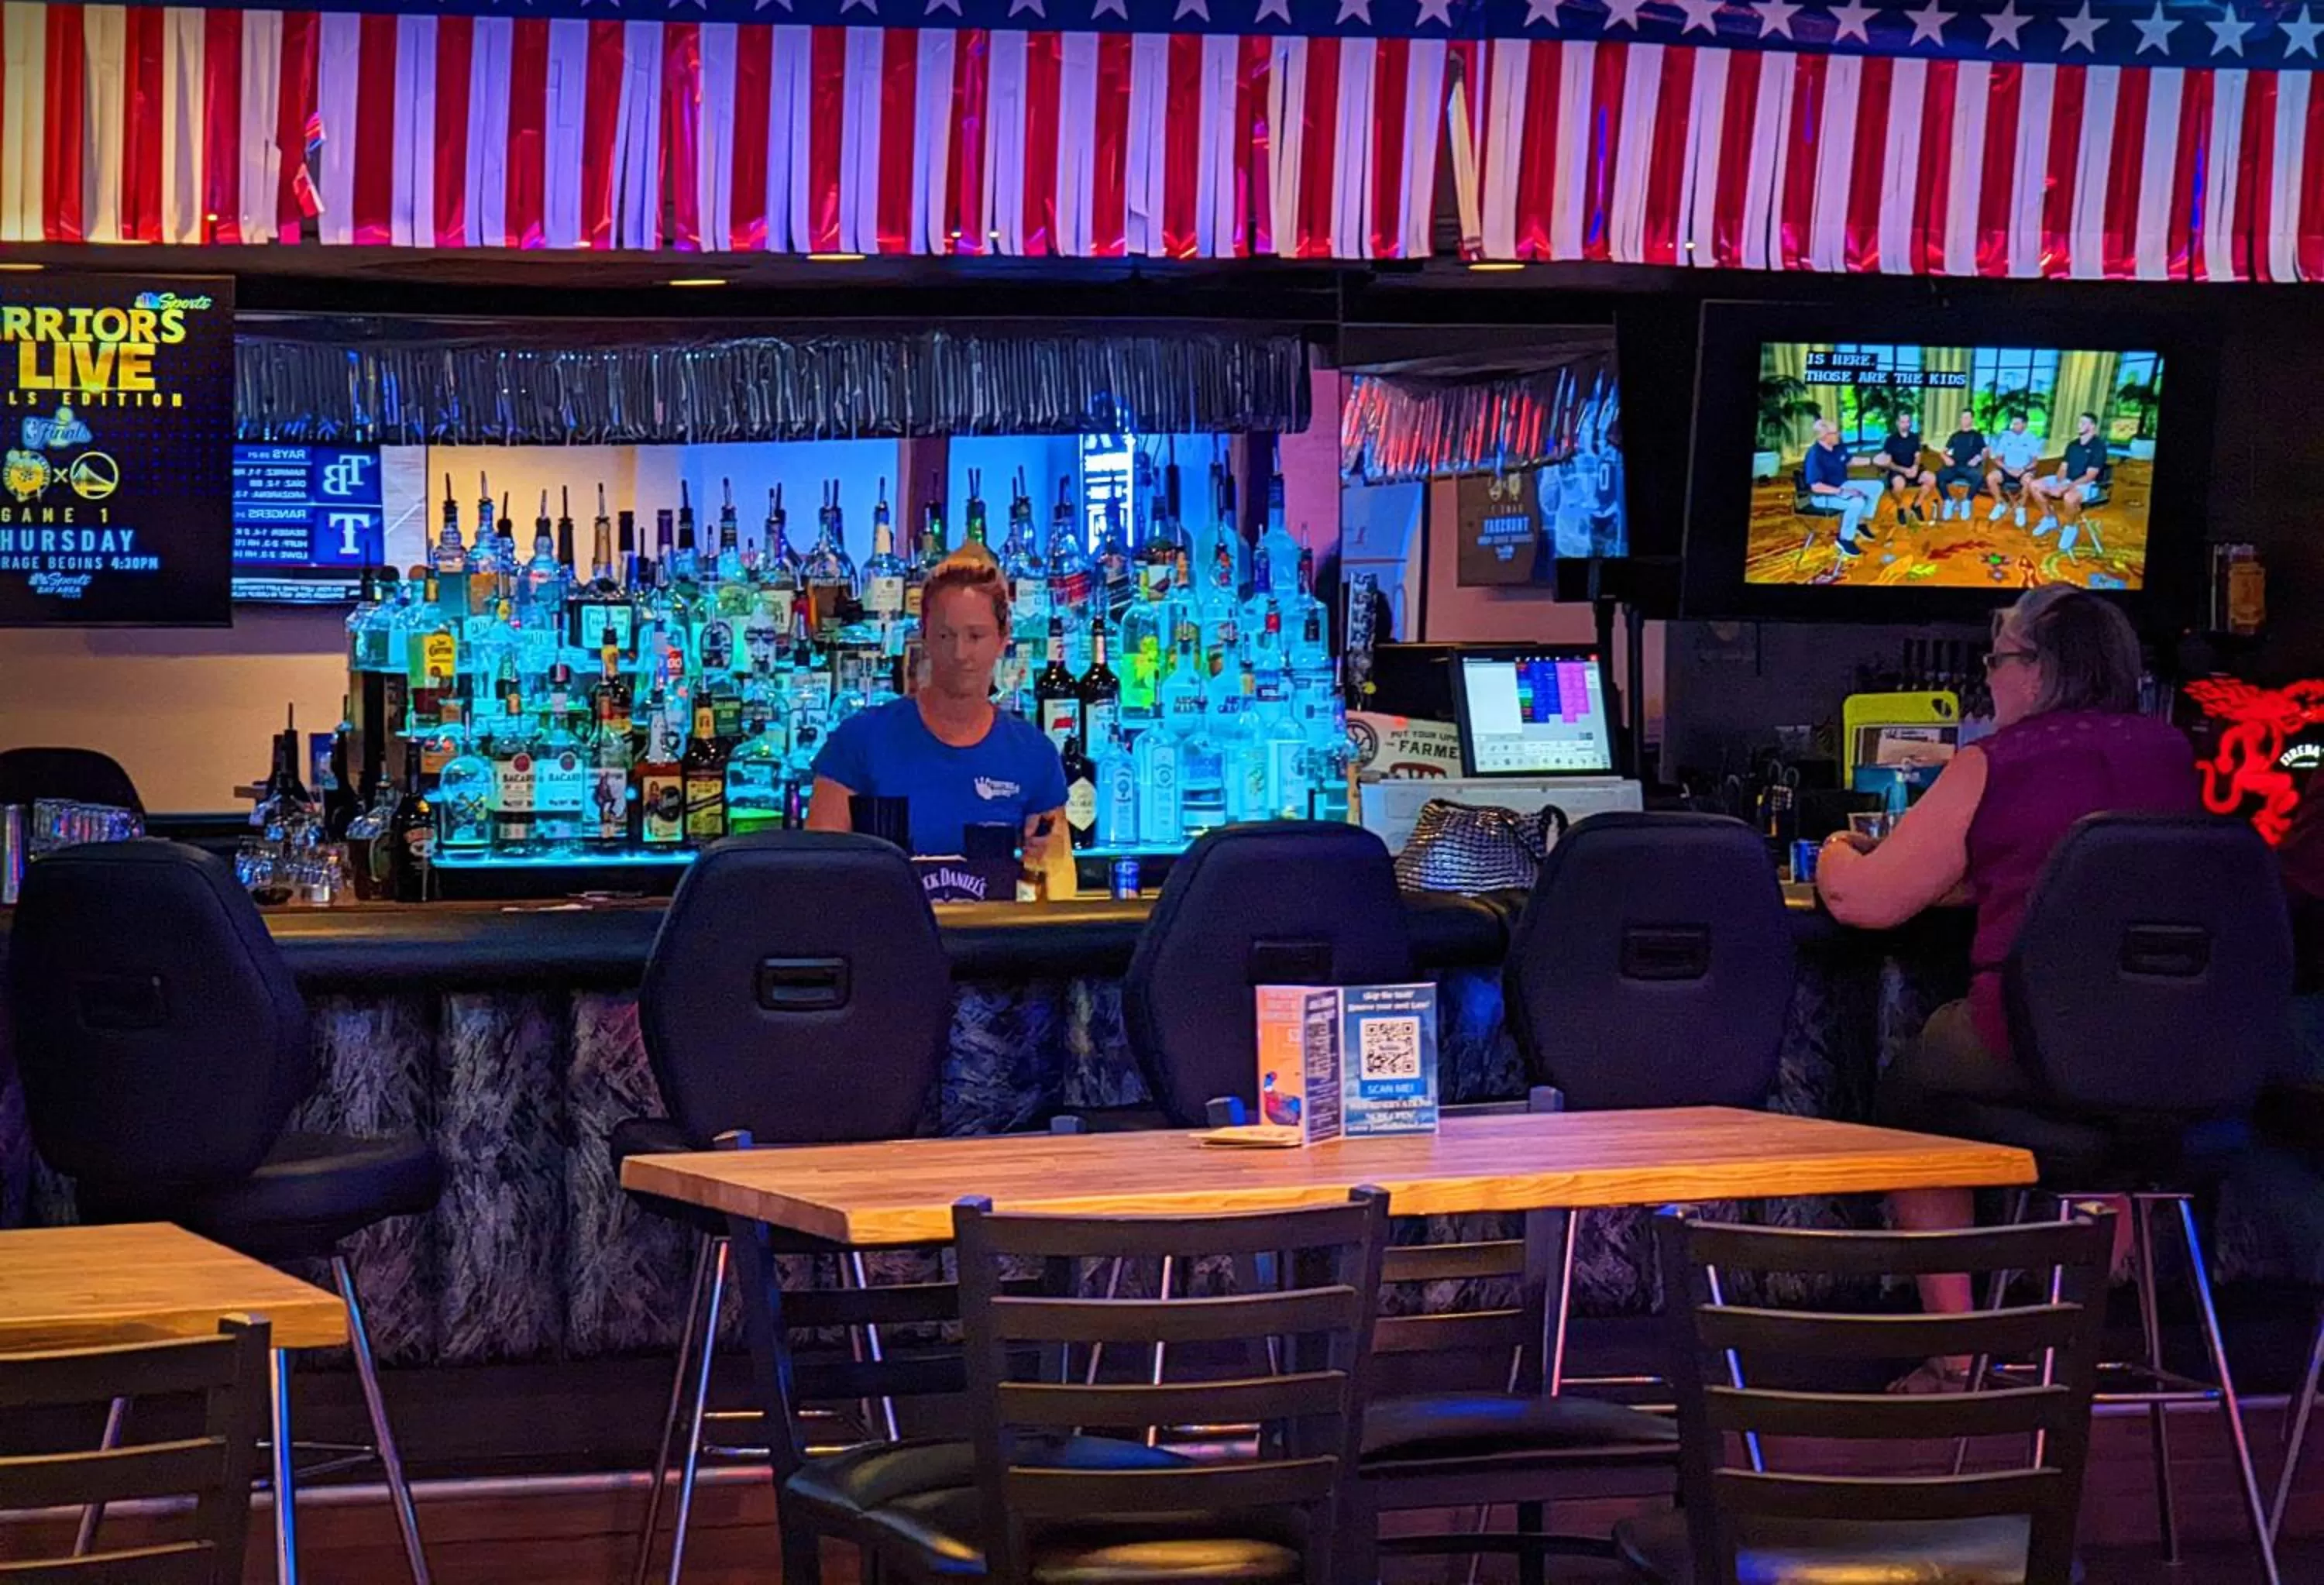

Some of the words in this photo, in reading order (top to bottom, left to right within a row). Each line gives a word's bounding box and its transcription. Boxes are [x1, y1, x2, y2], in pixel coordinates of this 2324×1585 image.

[159, 292, 211, 310] Sports
[0, 307, 186, 343] RRIORS
[19, 341, 155, 391] LIVE
[1807, 353, 1825, 365] IS
[1806, 370, 1852, 382] THOSE
[1858, 371, 1887, 383] ARE
[1894, 373, 1923, 384] THE
[1929, 373, 1965, 385] KIDS
[63, 392, 182, 407] EDITION
[1, 507, 74, 523] GAME
[99, 507, 109, 524] 1
[0, 529, 134, 552] HURSDAY
[1, 555, 40, 570] RAGE
[47, 555, 103, 570] BEGINS
[111, 555, 160, 570] 4:30PM
[2280, 744, 2324, 766] FIREBA
[923, 873, 940, 891] CK
